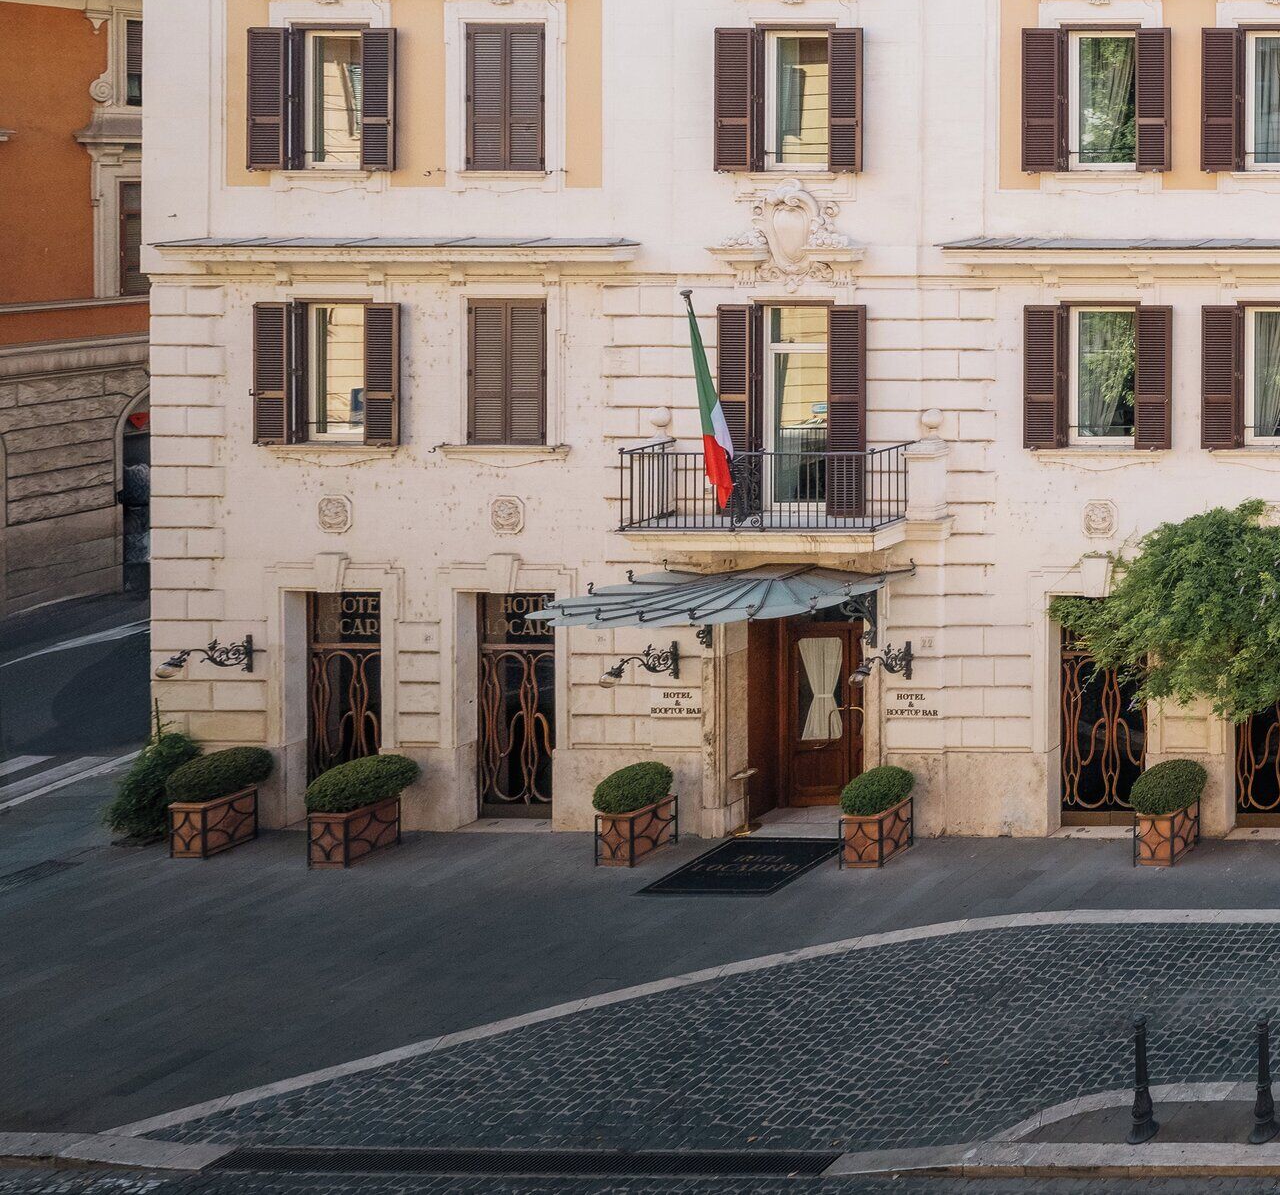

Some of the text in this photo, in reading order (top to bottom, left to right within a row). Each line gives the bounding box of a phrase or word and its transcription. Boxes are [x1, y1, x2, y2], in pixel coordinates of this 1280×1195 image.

[331, 596, 379, 614] HOTE
[651, 707, 685, 715] ROOFTOP
[886, 708, 939, 717] ROOFTOP BAR
